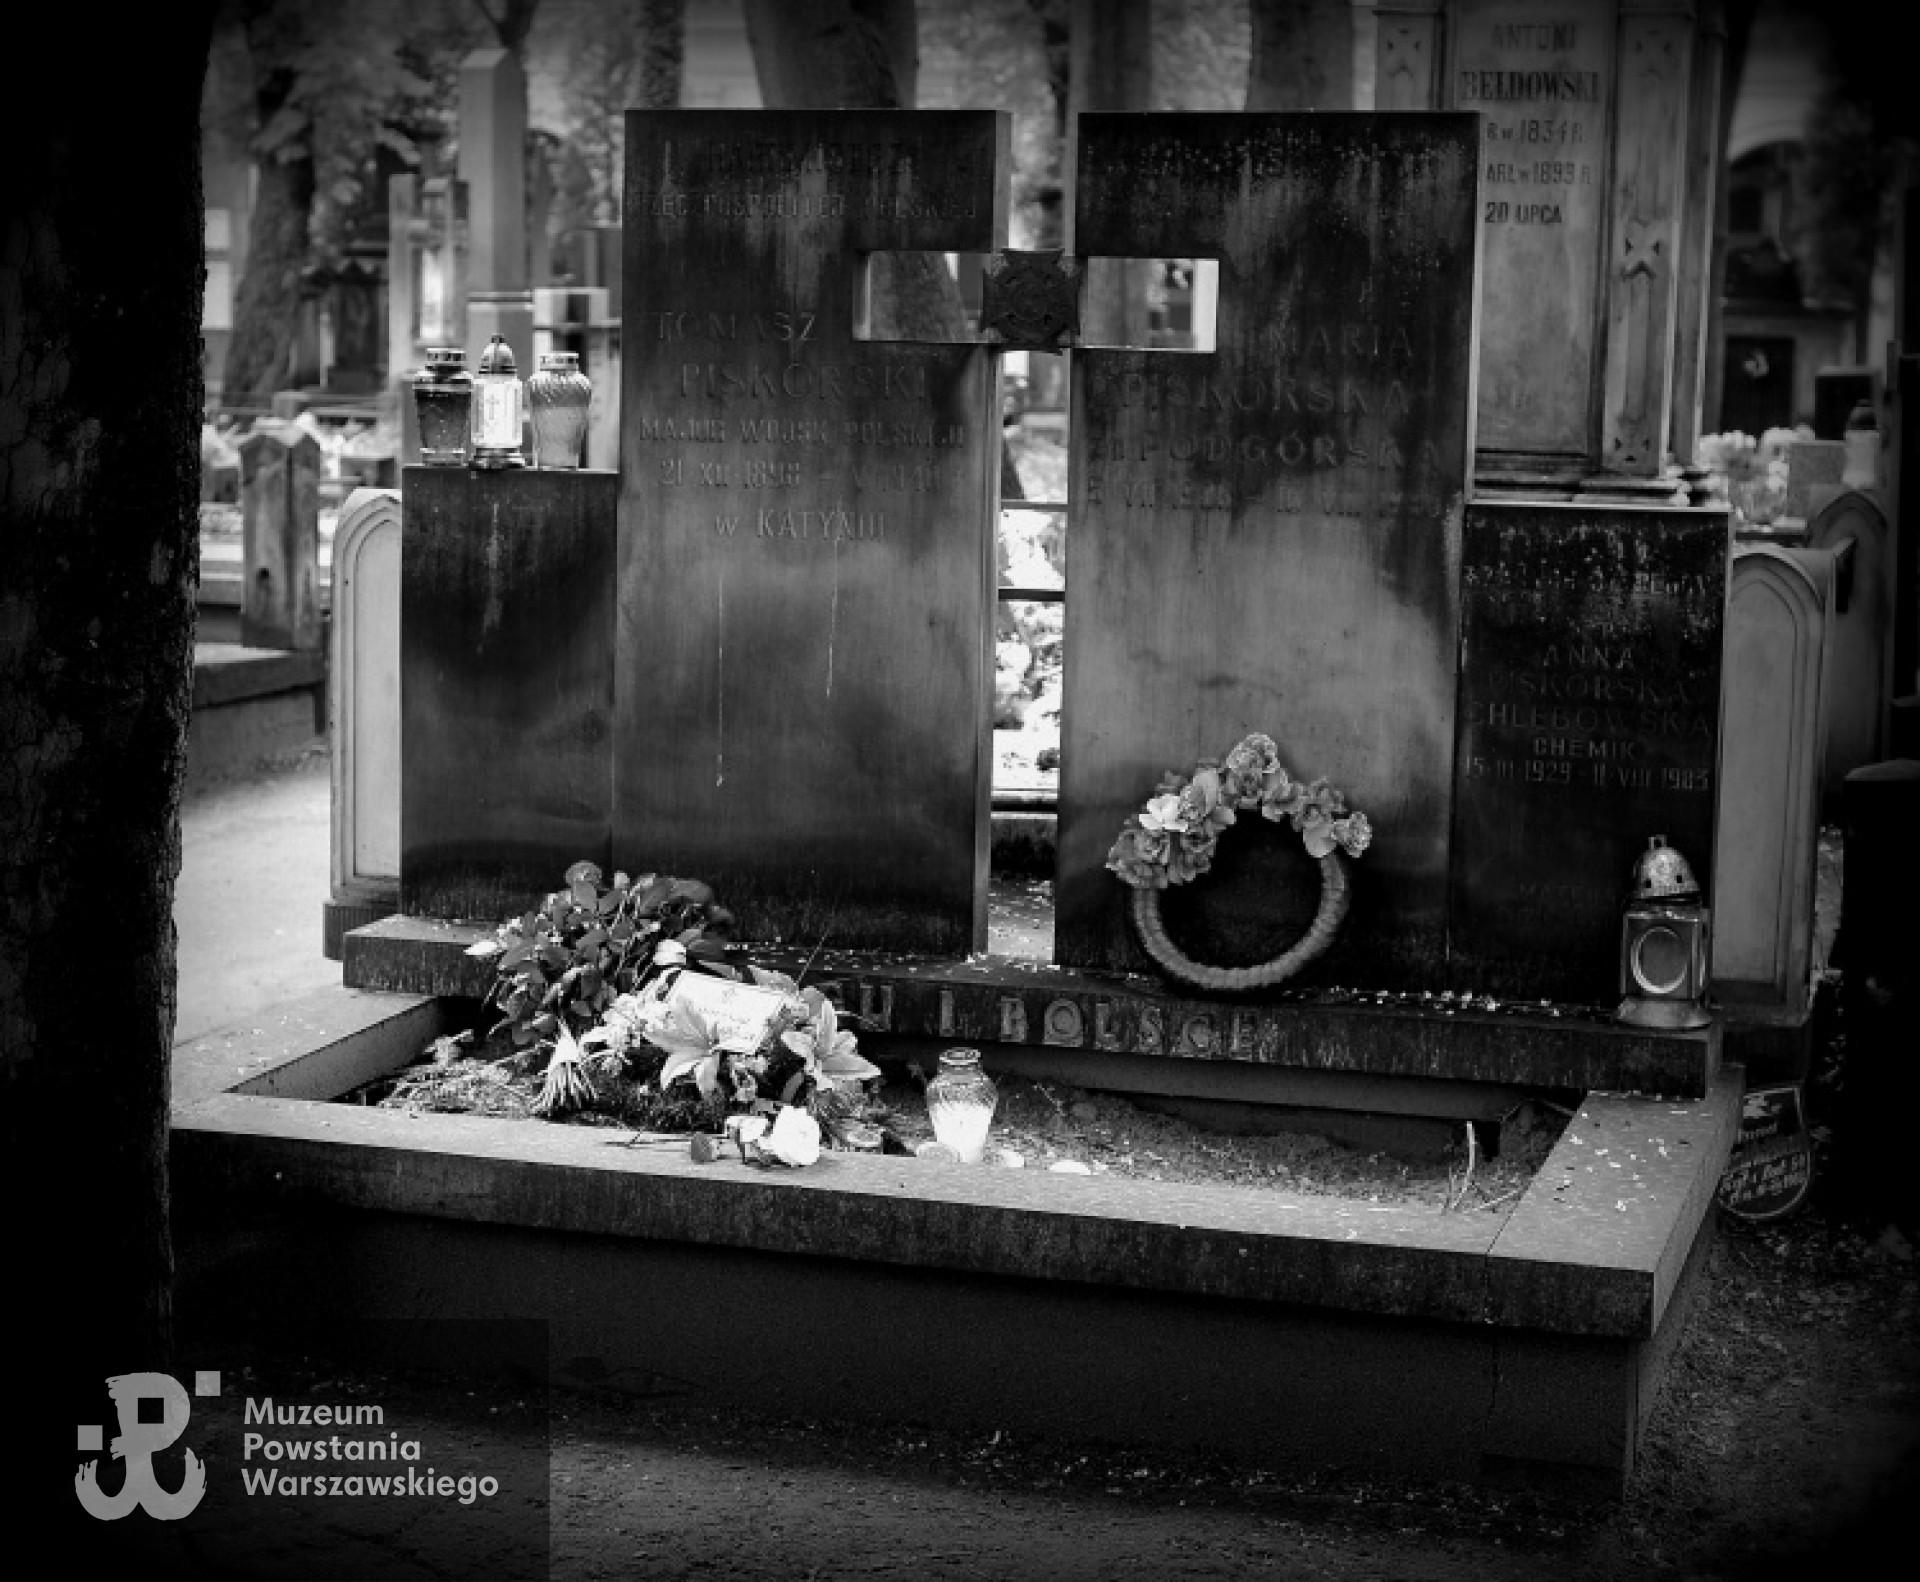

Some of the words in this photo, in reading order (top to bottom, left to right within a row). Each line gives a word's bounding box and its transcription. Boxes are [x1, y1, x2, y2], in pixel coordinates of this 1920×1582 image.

[1490, 22, 1578, 51] ANTONI
[1484, 201, 1509, 224] 20
[1542, 644, 1634, 671] ANNA
[1532, 736, 1637, 761] CHEMIK
